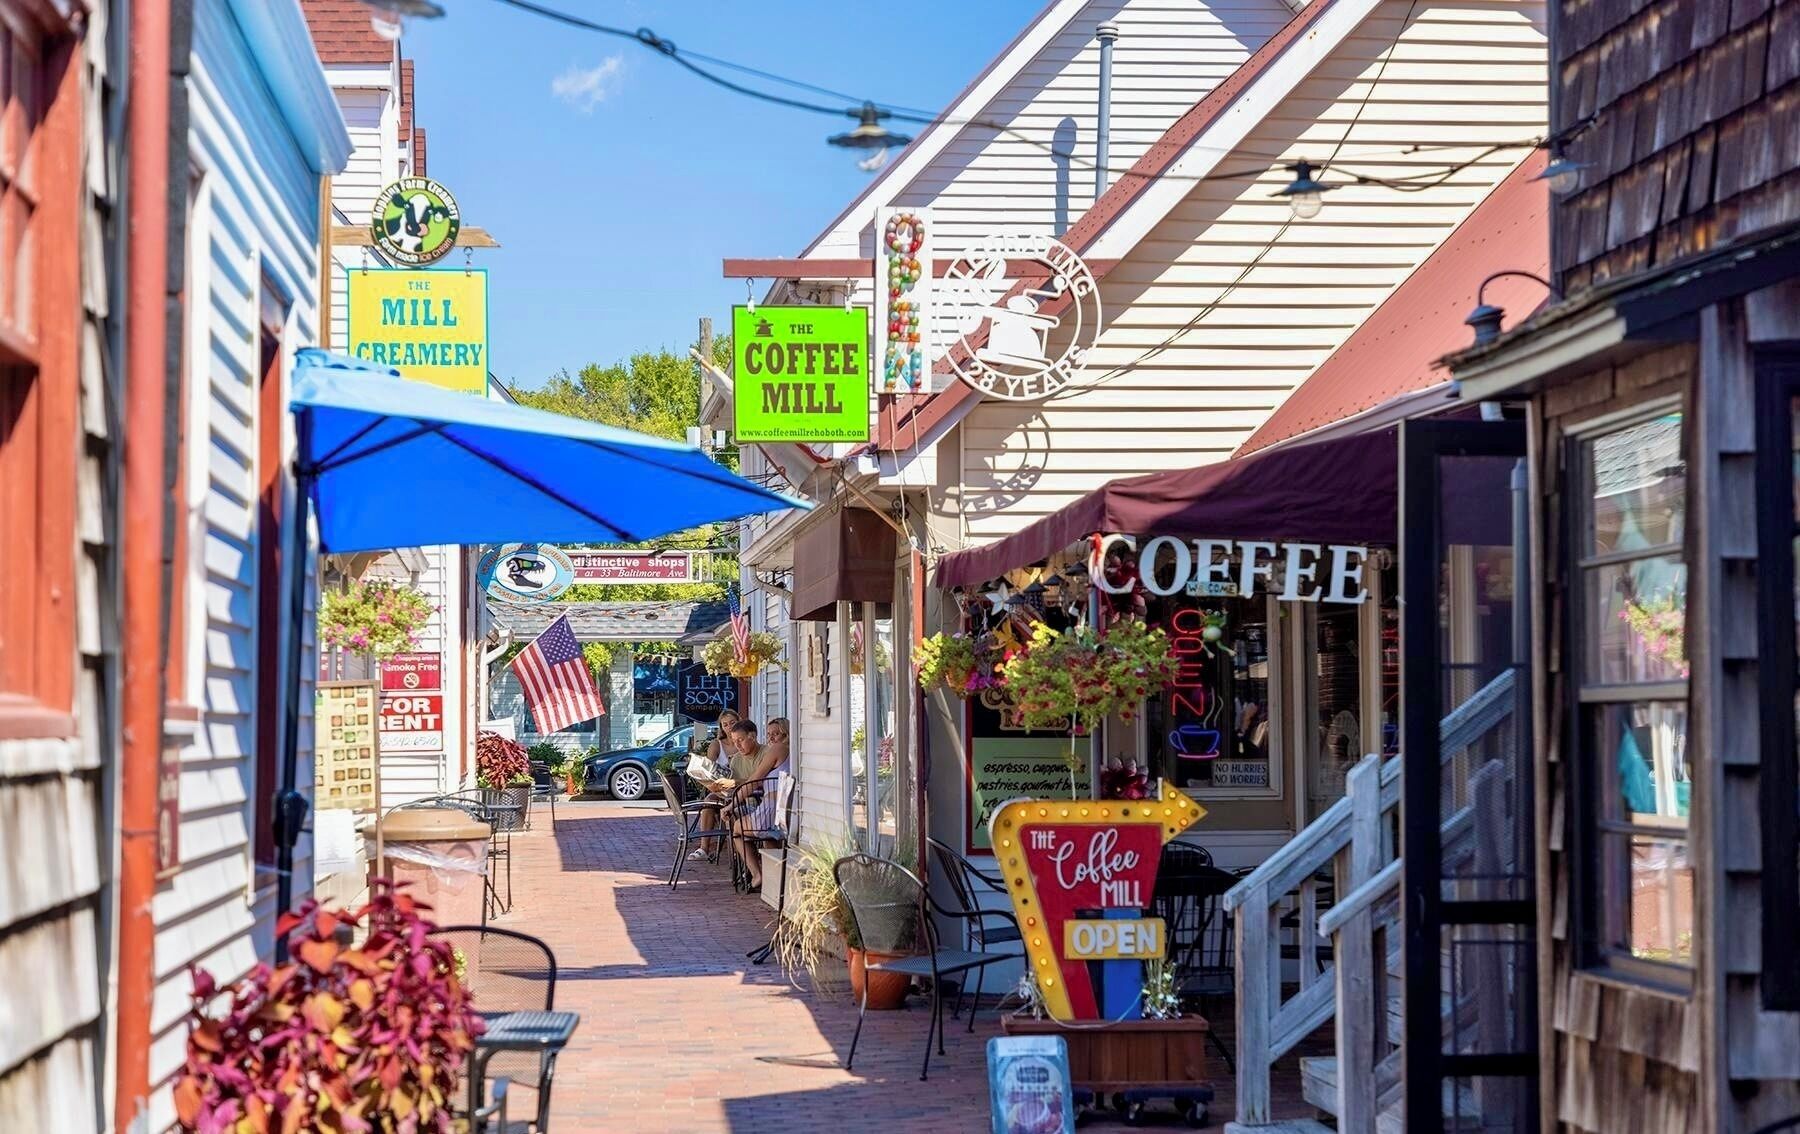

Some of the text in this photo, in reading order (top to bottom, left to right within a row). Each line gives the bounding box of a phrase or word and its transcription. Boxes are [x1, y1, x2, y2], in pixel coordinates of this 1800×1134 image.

[408, 281, 431, 290] THE
[382, 298, 457, 326] MILL
[789, 324, 814, 334] THE
[356, 342, 483, 366] CREAMERY
[745, 342, 859, 375] COFFEE
[965, 345, 1090, 398] 28 YEARS
[761, 382, 843, 414] MILL
[740, 428, 865, 437] www.coffeemillrehoboth.com
[574, 555, 685, 568] distinctive shops
[1088, 533, 1369, 604] COFFEE
[584, 569, 593, 577] at
[600, 569, 611, 577] 33
[618, 568, 661, 577] Baltimore
[417, 663, 439, 671] Free
[685, 675, 732, 689] LEH
[381, 697, 431, 714] FOR
[684, 690, 735, 709] SOAP
[1215, 763, 1267, 773] NO HURRIES
[1214, 774, 1266, 784] NO WORRIES
[1030, 830, 1056, 850] THE
[1047, 828, 1140, 889] Coffee
[1101, 880, 1143, 907] MILL
[1072, 923, 1157, 955] OPEN
